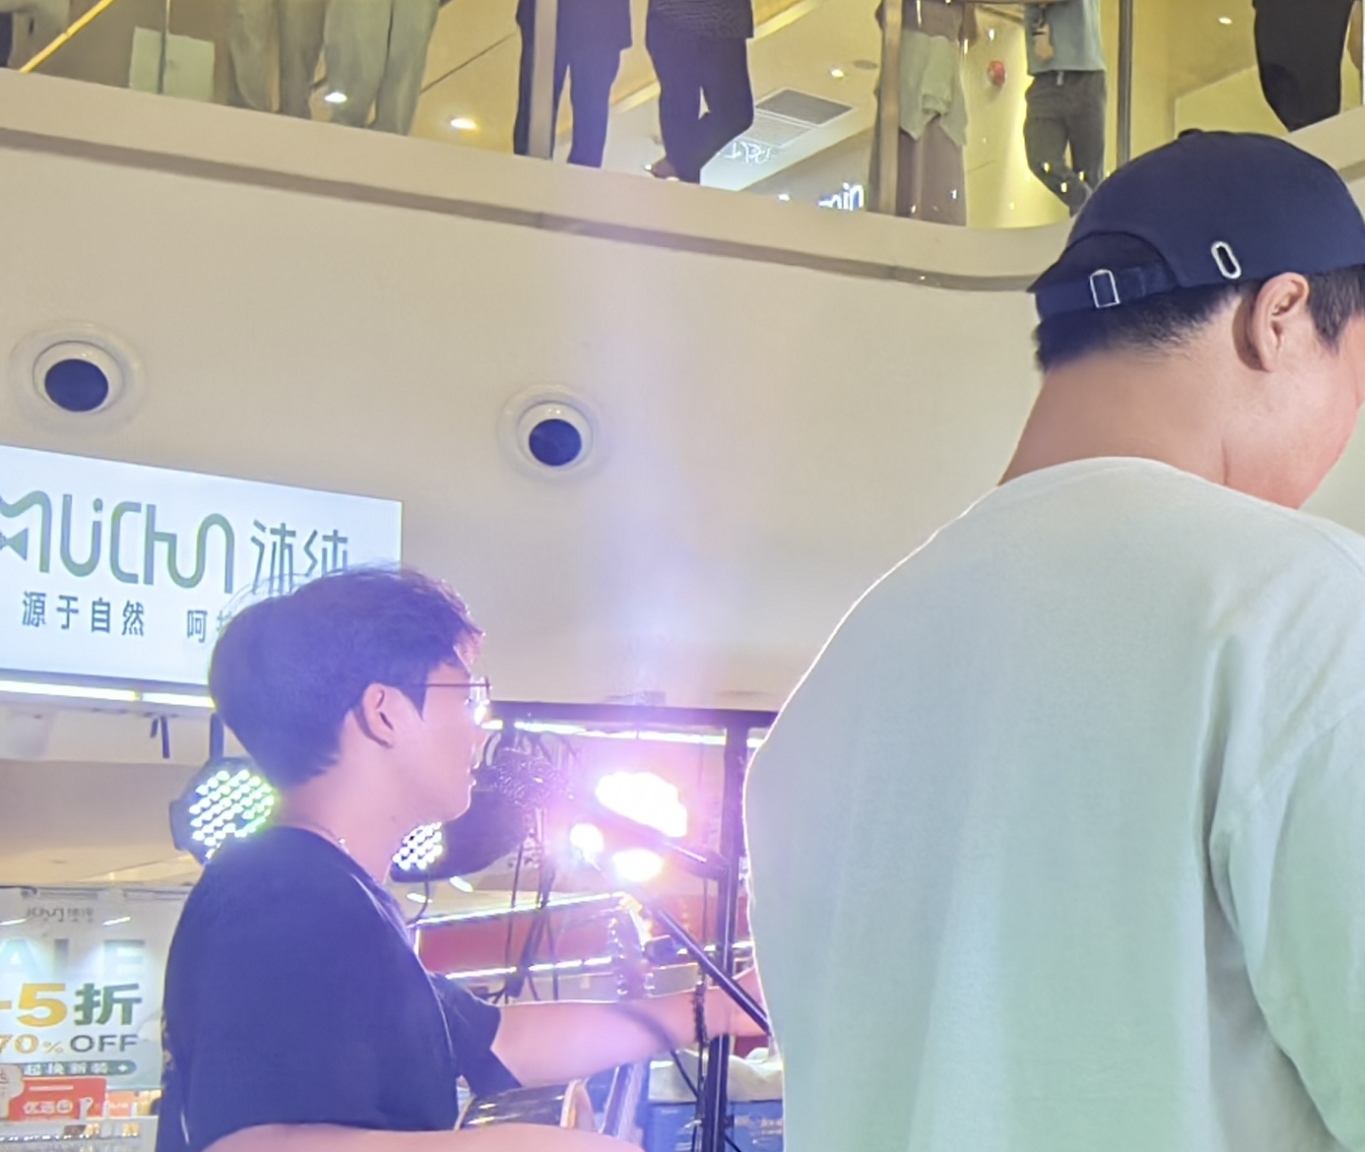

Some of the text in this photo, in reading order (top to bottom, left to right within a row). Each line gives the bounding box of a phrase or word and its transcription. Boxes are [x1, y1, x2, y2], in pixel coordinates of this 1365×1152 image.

[22, 590, 145, 636] 源于自然
[70, 1033, 138, 1053] OFF
